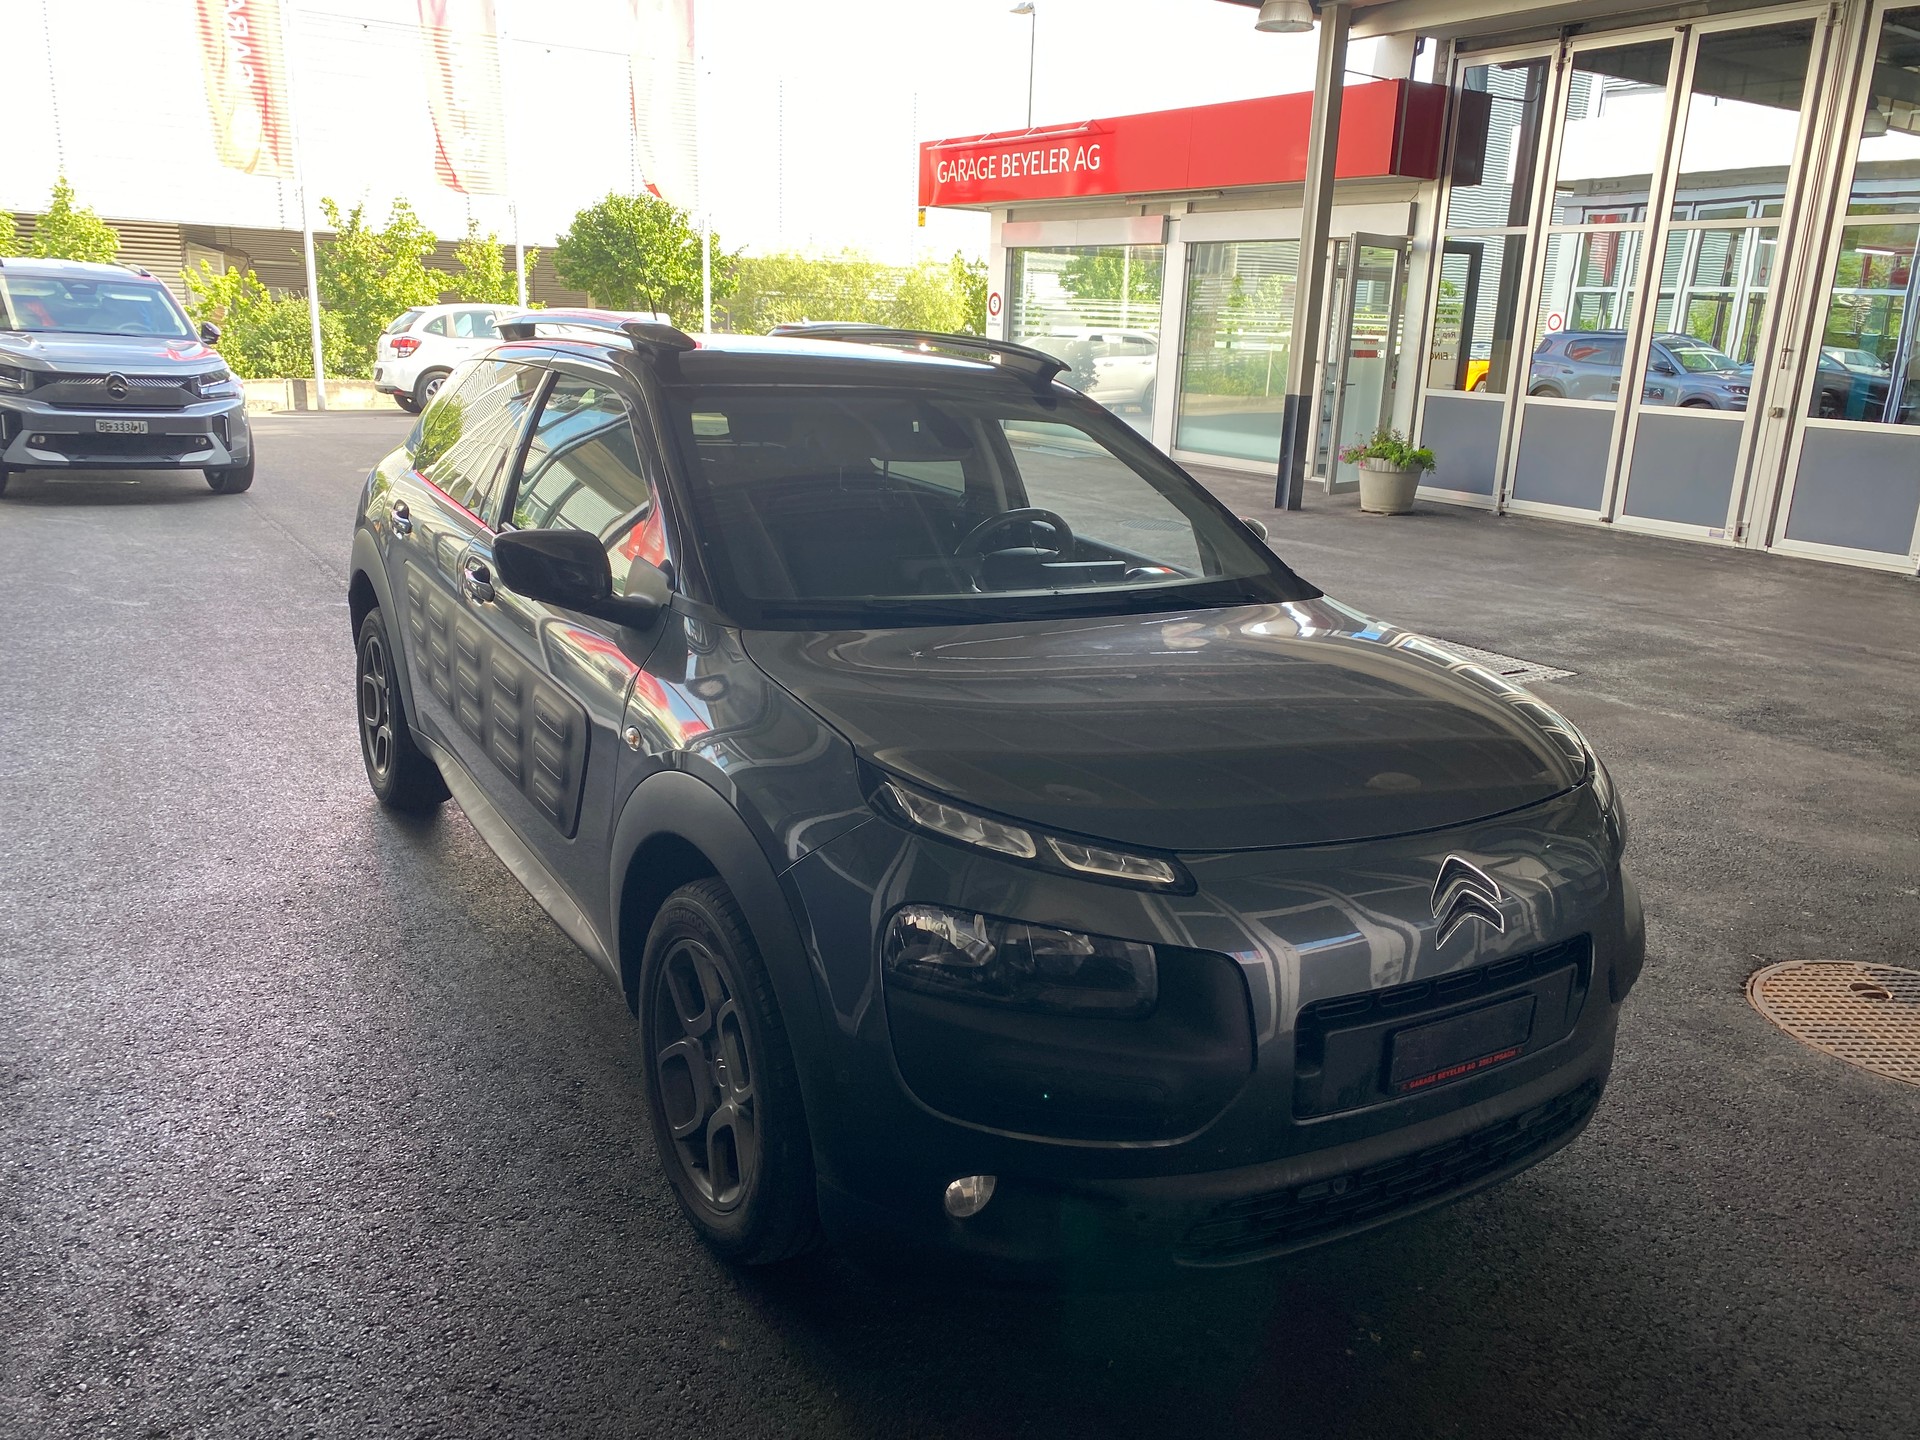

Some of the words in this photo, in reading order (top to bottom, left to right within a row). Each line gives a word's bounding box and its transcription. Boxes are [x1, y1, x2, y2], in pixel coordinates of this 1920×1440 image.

[937, 156, 997, 184] GARAGE
[1001, 147, 1069, 178] BEYELER
[1073, 143, 1101, 172] AG
[1409, 1074, 1437, 1089] GARAGE
[1437, 1065, 1467, 1081] BEYELER
[1466, 1062, 1476, 1072] AG
